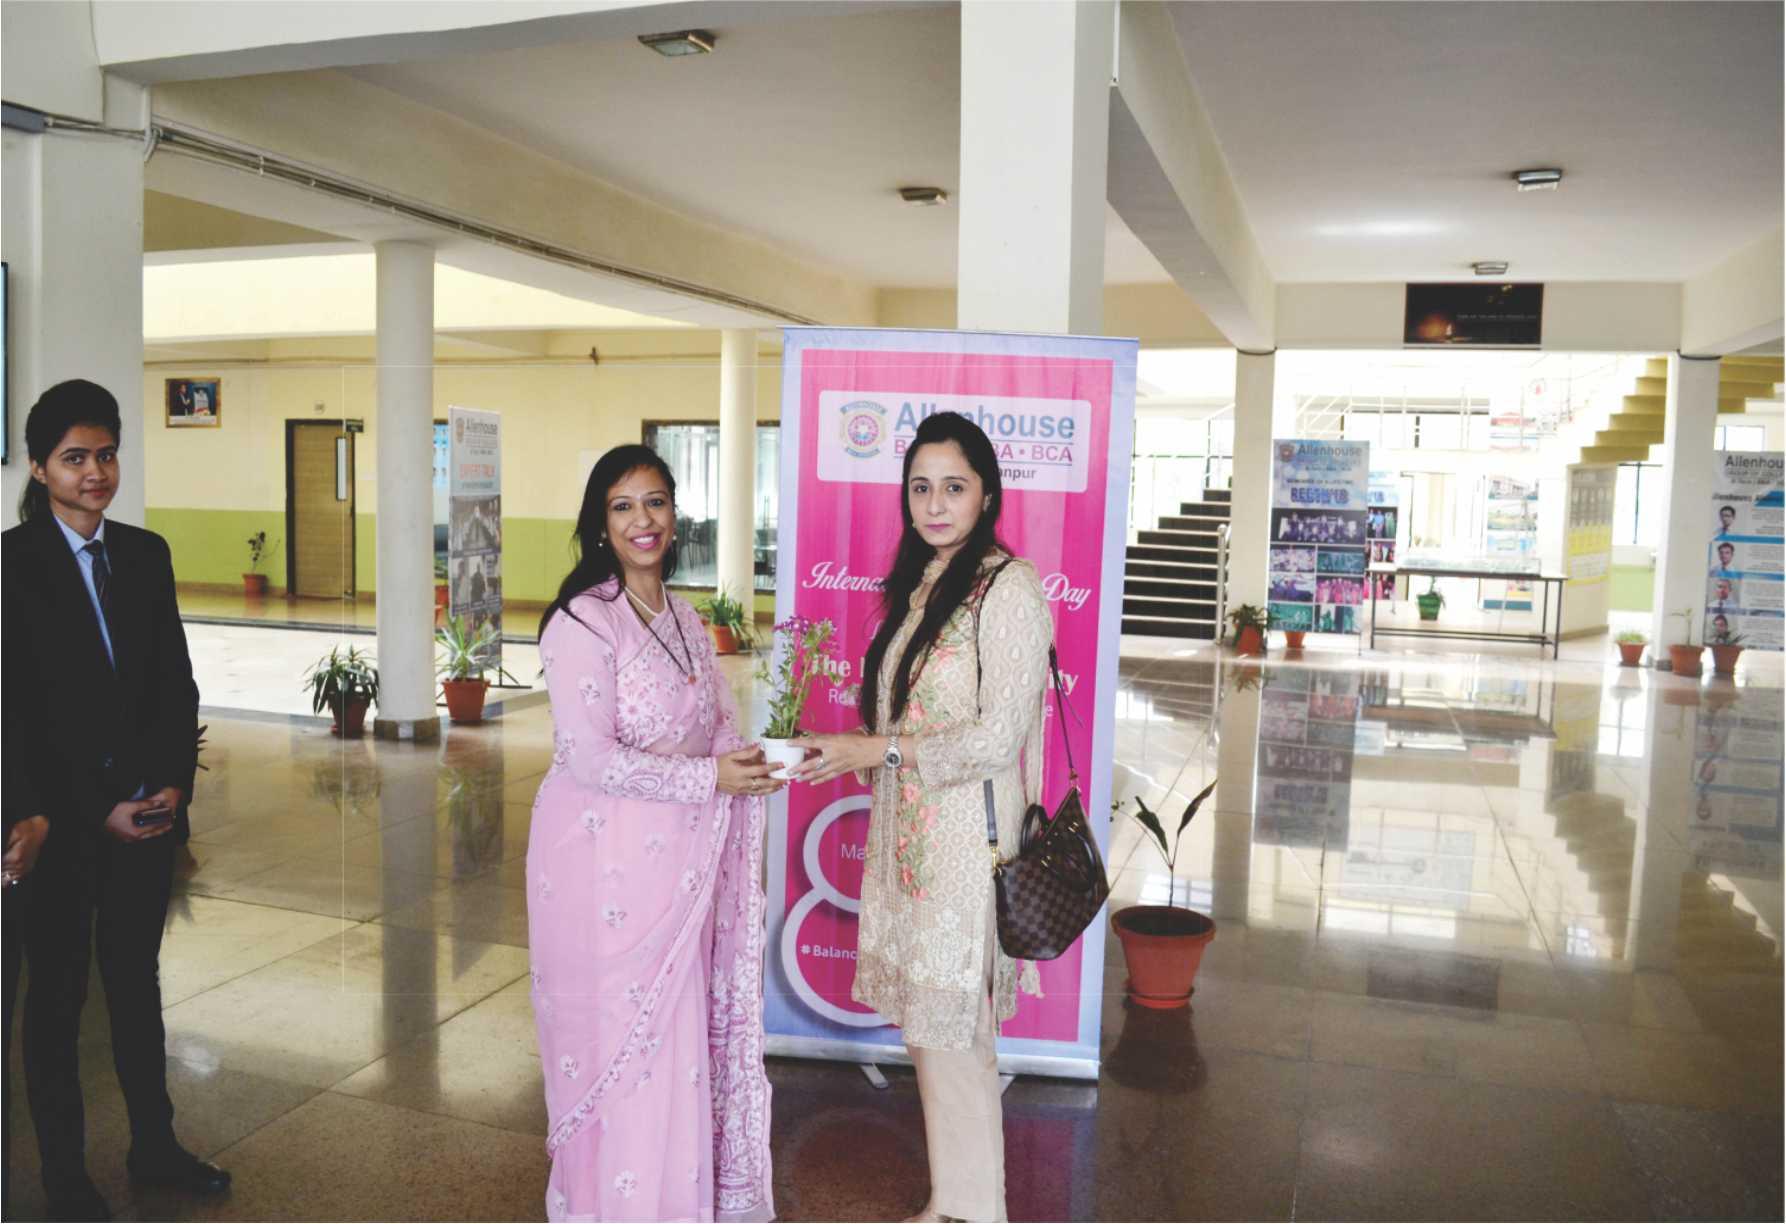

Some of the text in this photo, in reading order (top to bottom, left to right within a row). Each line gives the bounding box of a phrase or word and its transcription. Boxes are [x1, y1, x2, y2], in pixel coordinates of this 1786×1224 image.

[895, 401, 1075, 438] Alhouse
[1031, 445, 1072, 462] BCA
[1297, 443, 1363, 457] Allenhouse
[1725, 454, 1784, 469] Allenhou
[999, 467, 1036, 481] npur
[802, 561, 1092, 611] Interna Day
